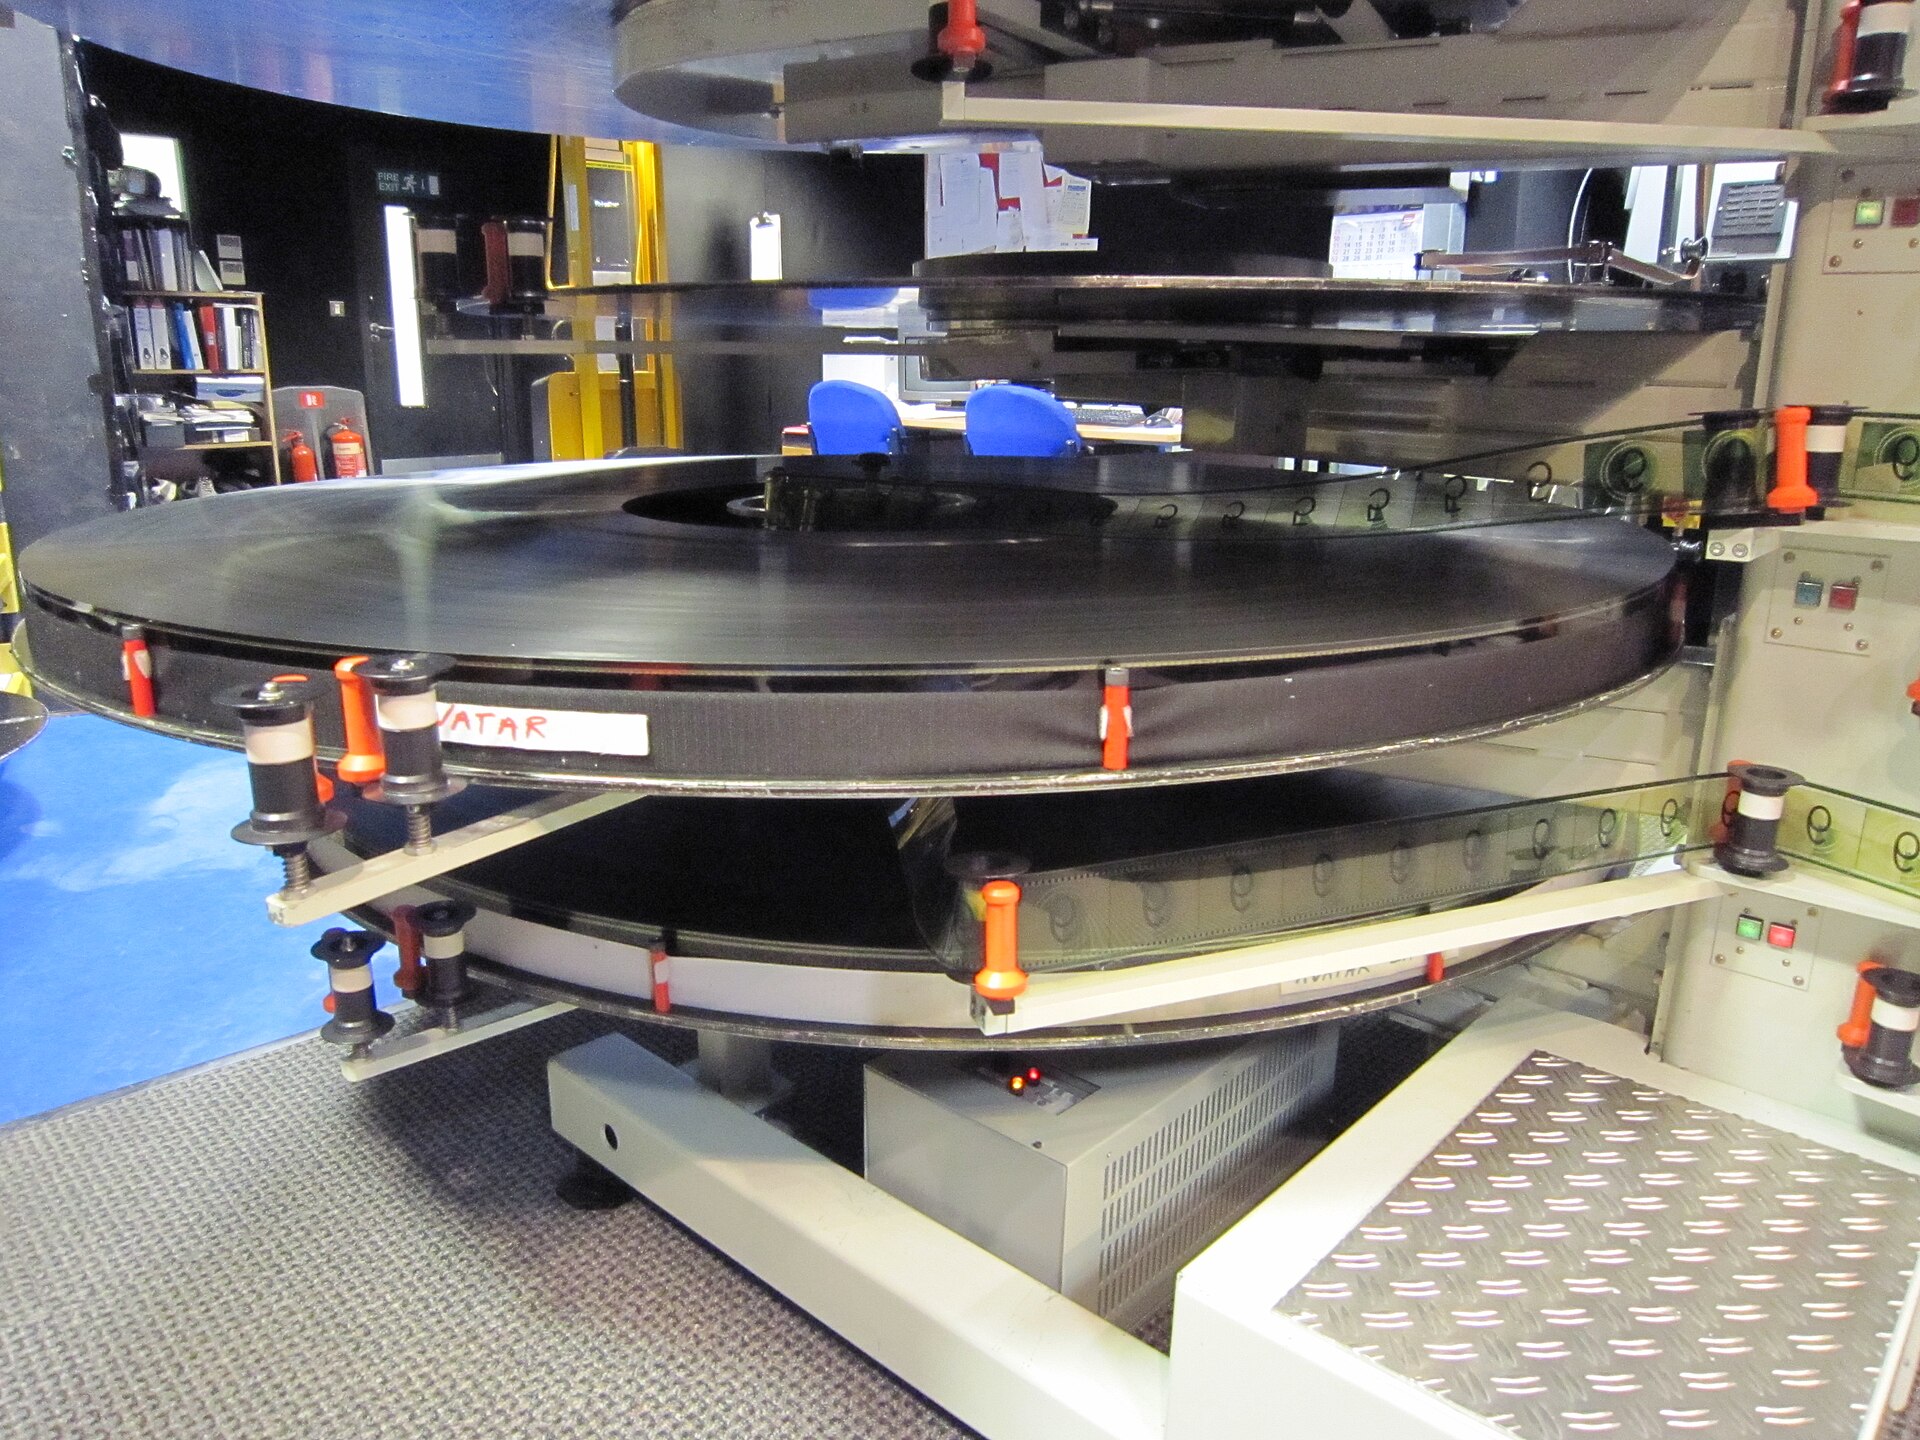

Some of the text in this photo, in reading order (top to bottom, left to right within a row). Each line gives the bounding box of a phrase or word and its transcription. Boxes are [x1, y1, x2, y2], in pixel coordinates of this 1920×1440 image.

[378, 172, 399, 181] FIRE
[379, 182, 399, 191] EXIT
[436, 703, 547, 741] VATAR
